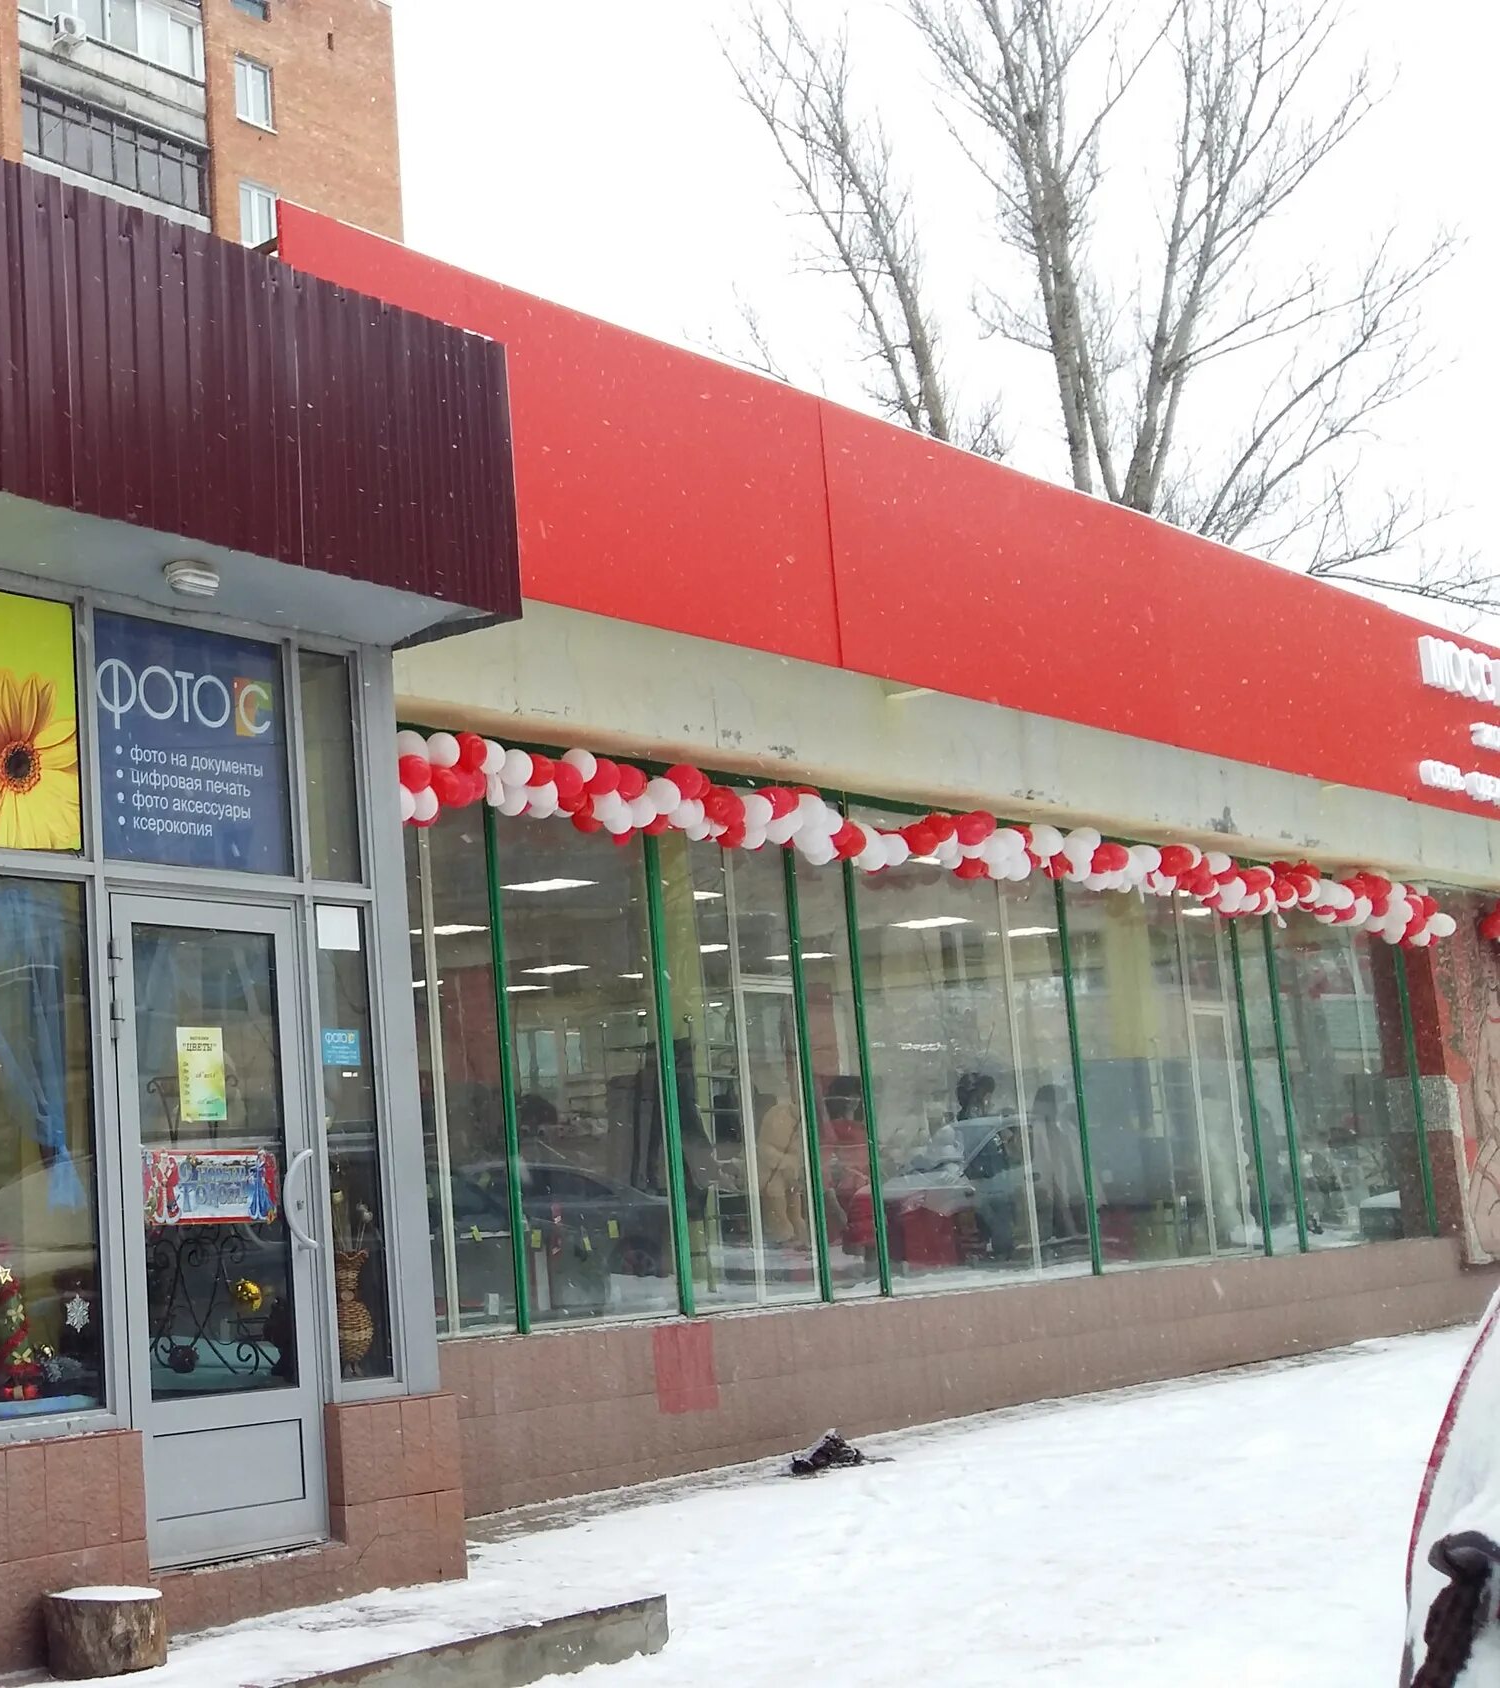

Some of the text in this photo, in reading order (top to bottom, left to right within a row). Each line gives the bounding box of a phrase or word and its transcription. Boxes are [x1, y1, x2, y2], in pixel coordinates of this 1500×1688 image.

[130, 744, 263, 777] фото на документы
[131, 769, 251, 797] цифровая печать
[132, 790, 251, 821] фото аксессуары
[133, 816, 213, 836] ксерокопия
